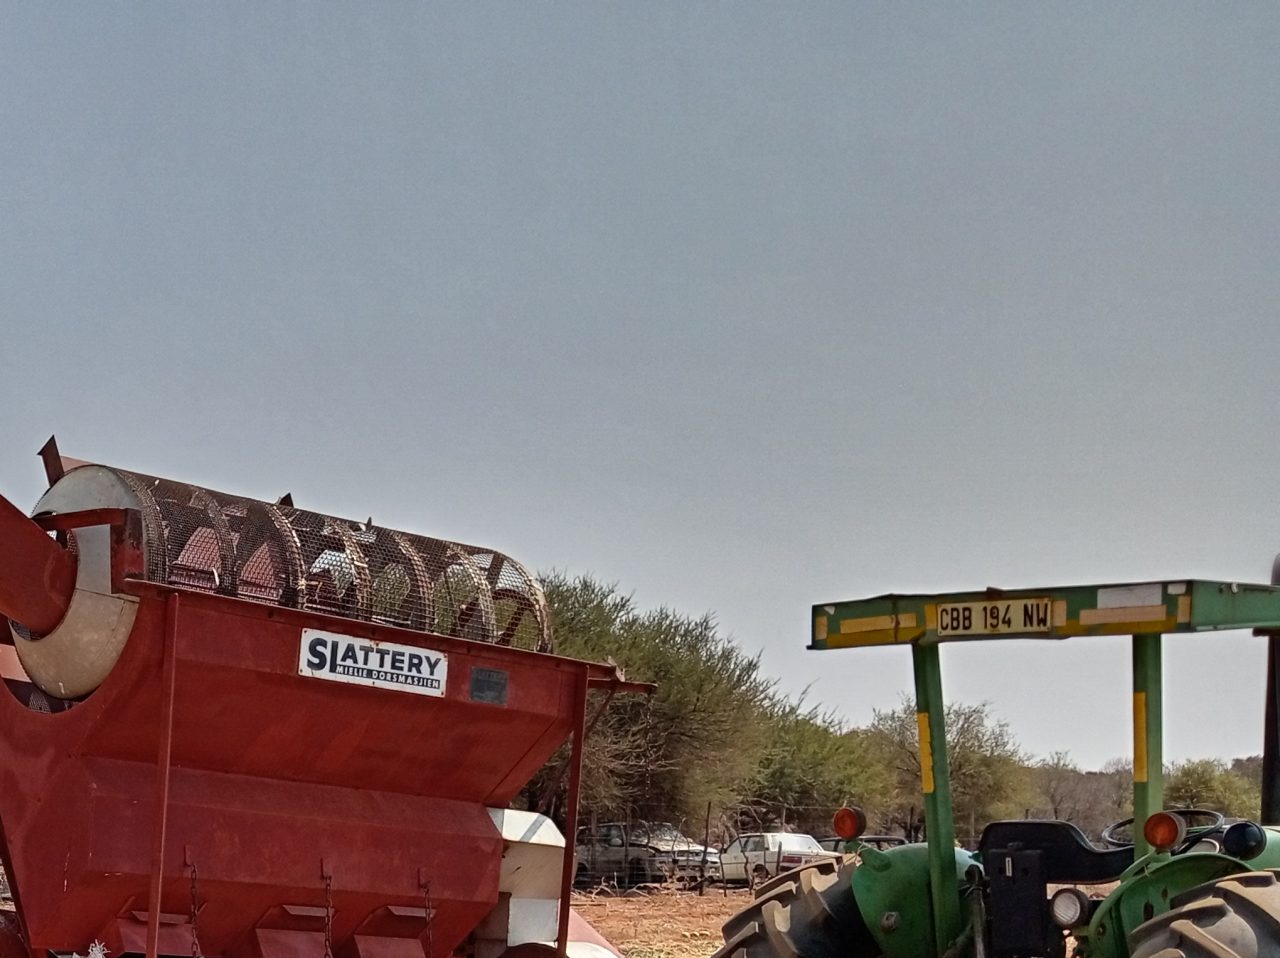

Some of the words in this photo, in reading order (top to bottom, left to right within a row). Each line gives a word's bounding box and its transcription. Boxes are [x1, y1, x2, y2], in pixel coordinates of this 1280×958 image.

[941, 607, 972, 630] CBB
[982, 604, 1012, 629] 194
[1023, 603, 1048, 627] NW
[336, 665, 368, 678] MIELIE
[372, 670, 440, 689] DORSMASJIEN
